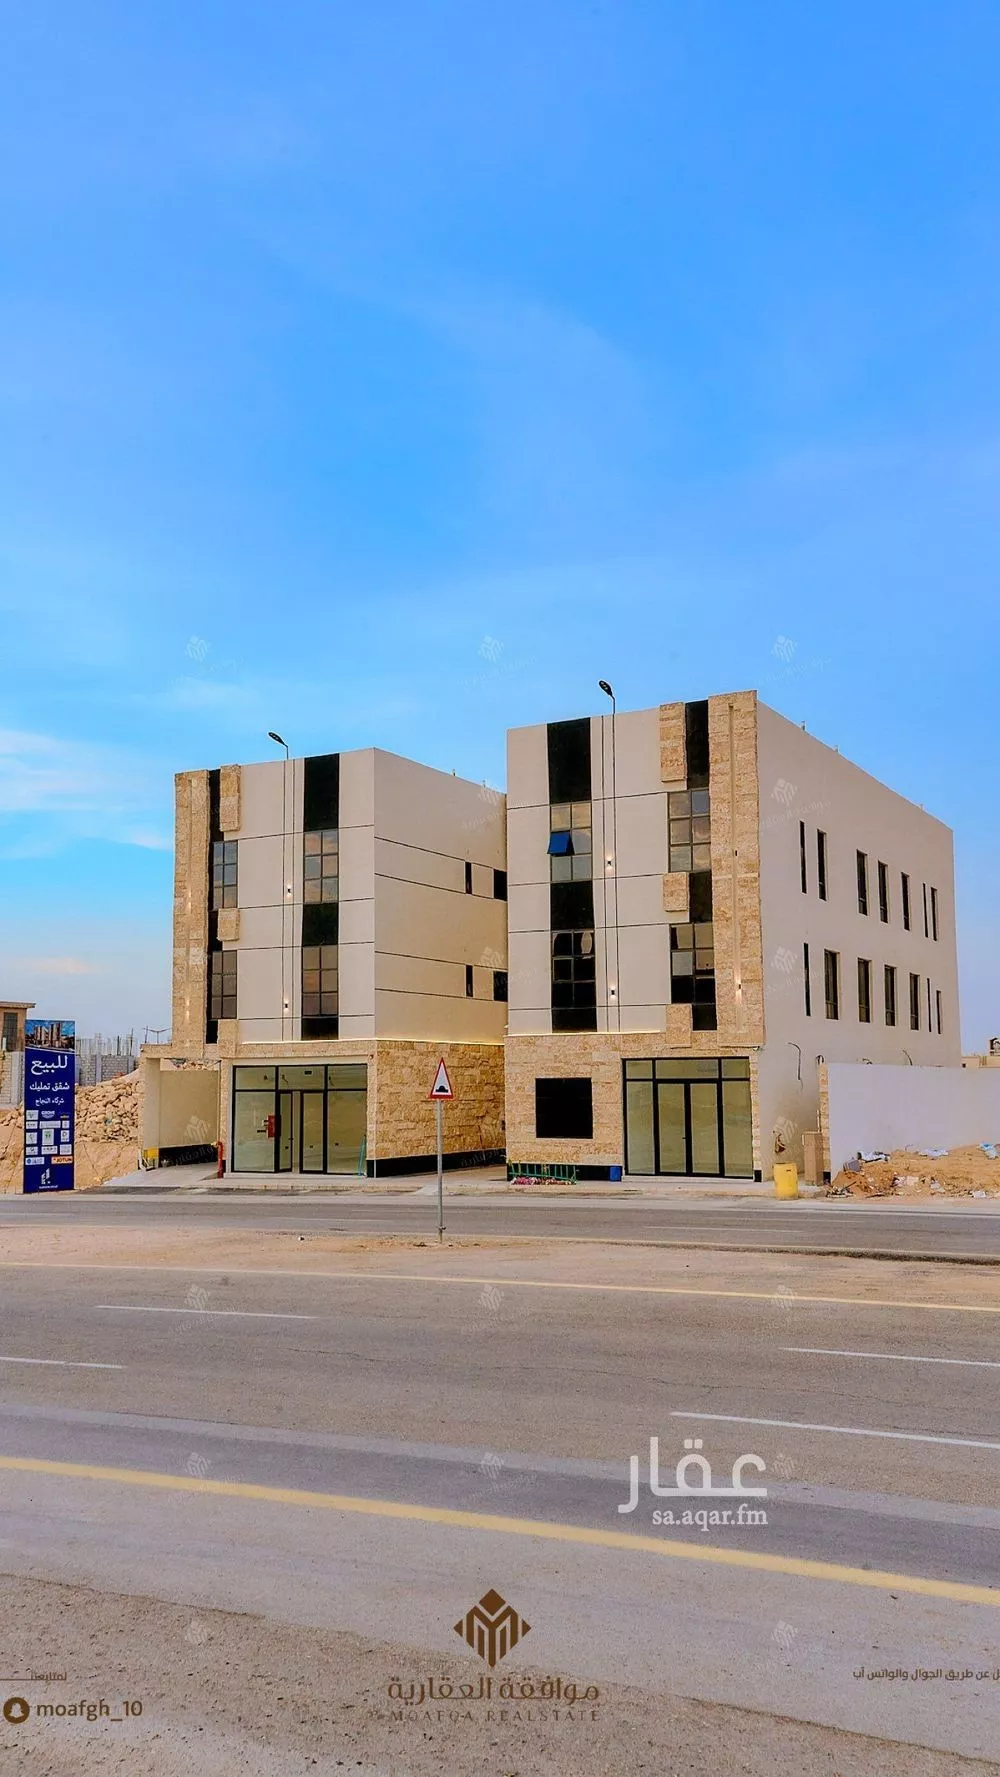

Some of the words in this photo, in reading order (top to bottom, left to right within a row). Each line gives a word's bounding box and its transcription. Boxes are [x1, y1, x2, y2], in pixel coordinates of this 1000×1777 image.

[31, 1055, 68, 1075] للبيع
[30, 1081, 50, 1092] تمليك
[52, 1082, 70, 1092] شقق
